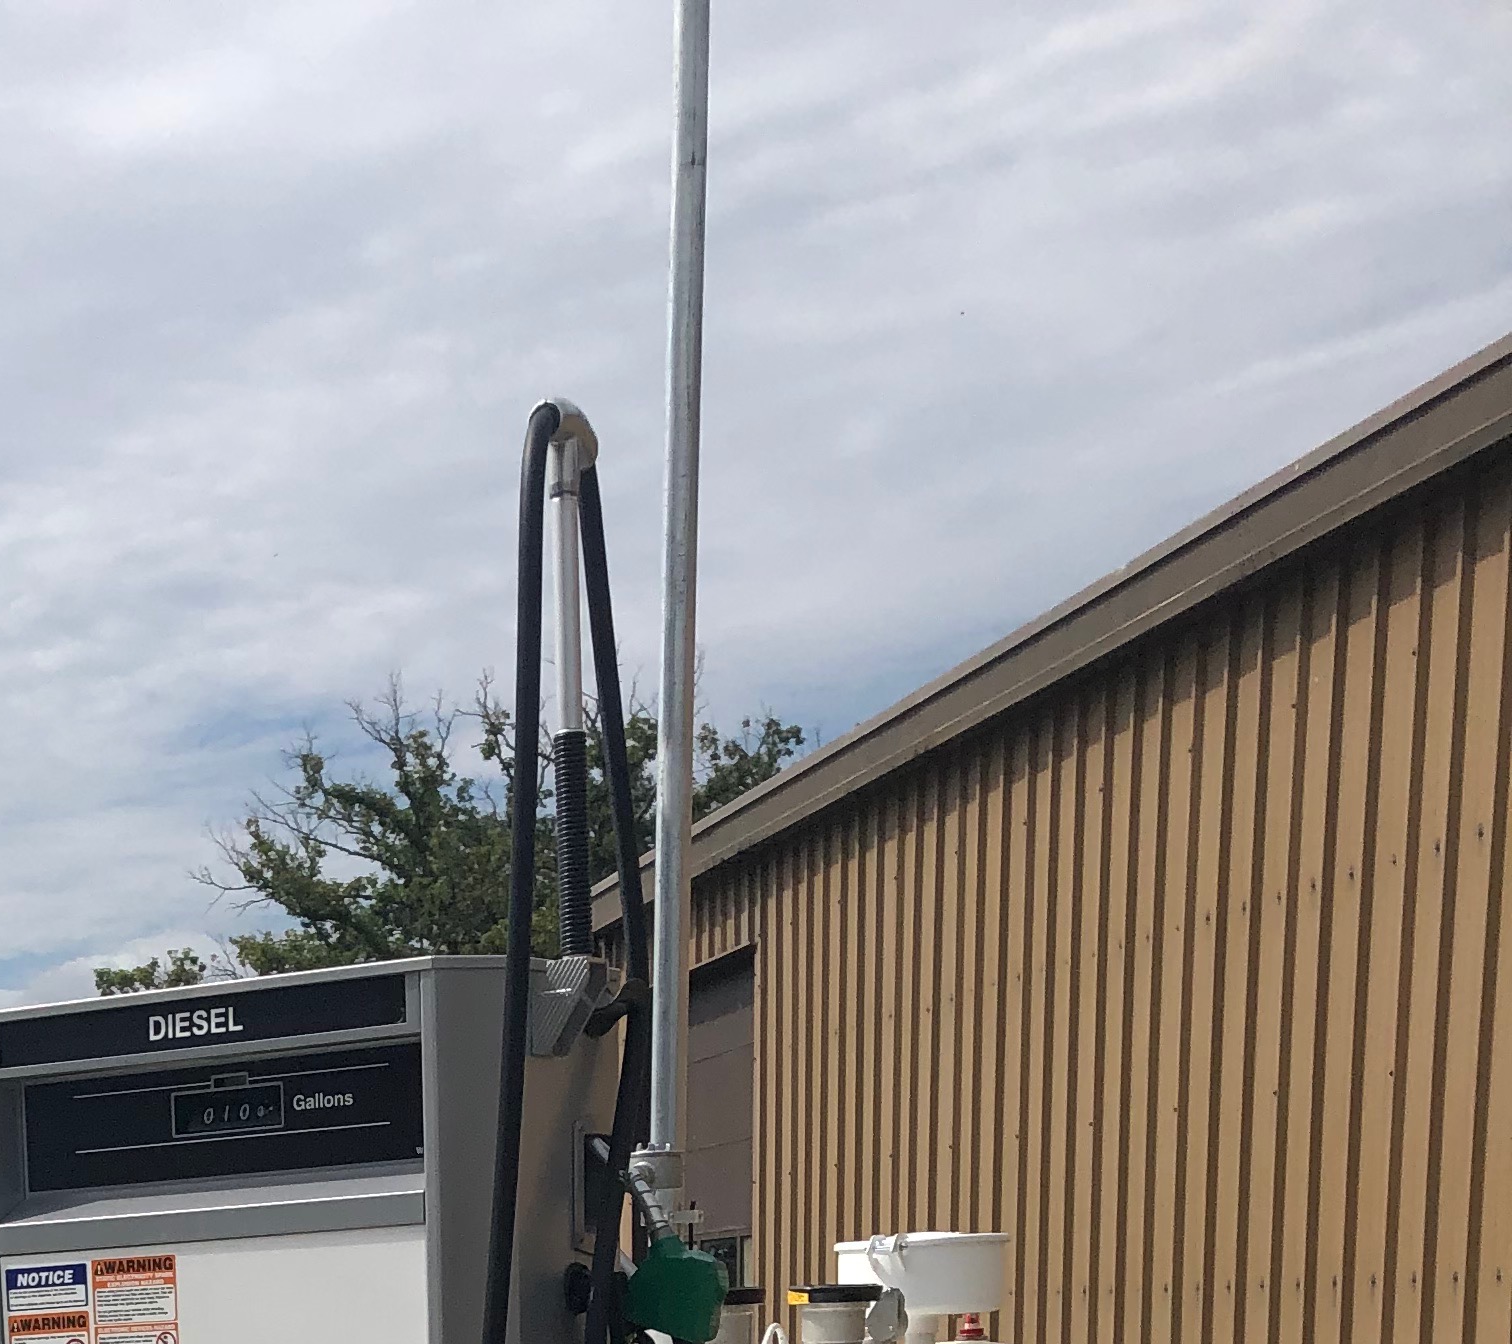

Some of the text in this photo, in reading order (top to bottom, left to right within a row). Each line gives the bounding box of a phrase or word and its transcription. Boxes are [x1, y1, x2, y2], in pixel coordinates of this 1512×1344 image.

[148, 1006, 244, 1041] DIESEL
[292, 1092, 354, 1111] Gallons
[103, 1257, 174, 1274] WARNING
[16, 1269, 75, 1287] NOTICE
[19, 1315, 87, 1332] WARNING
